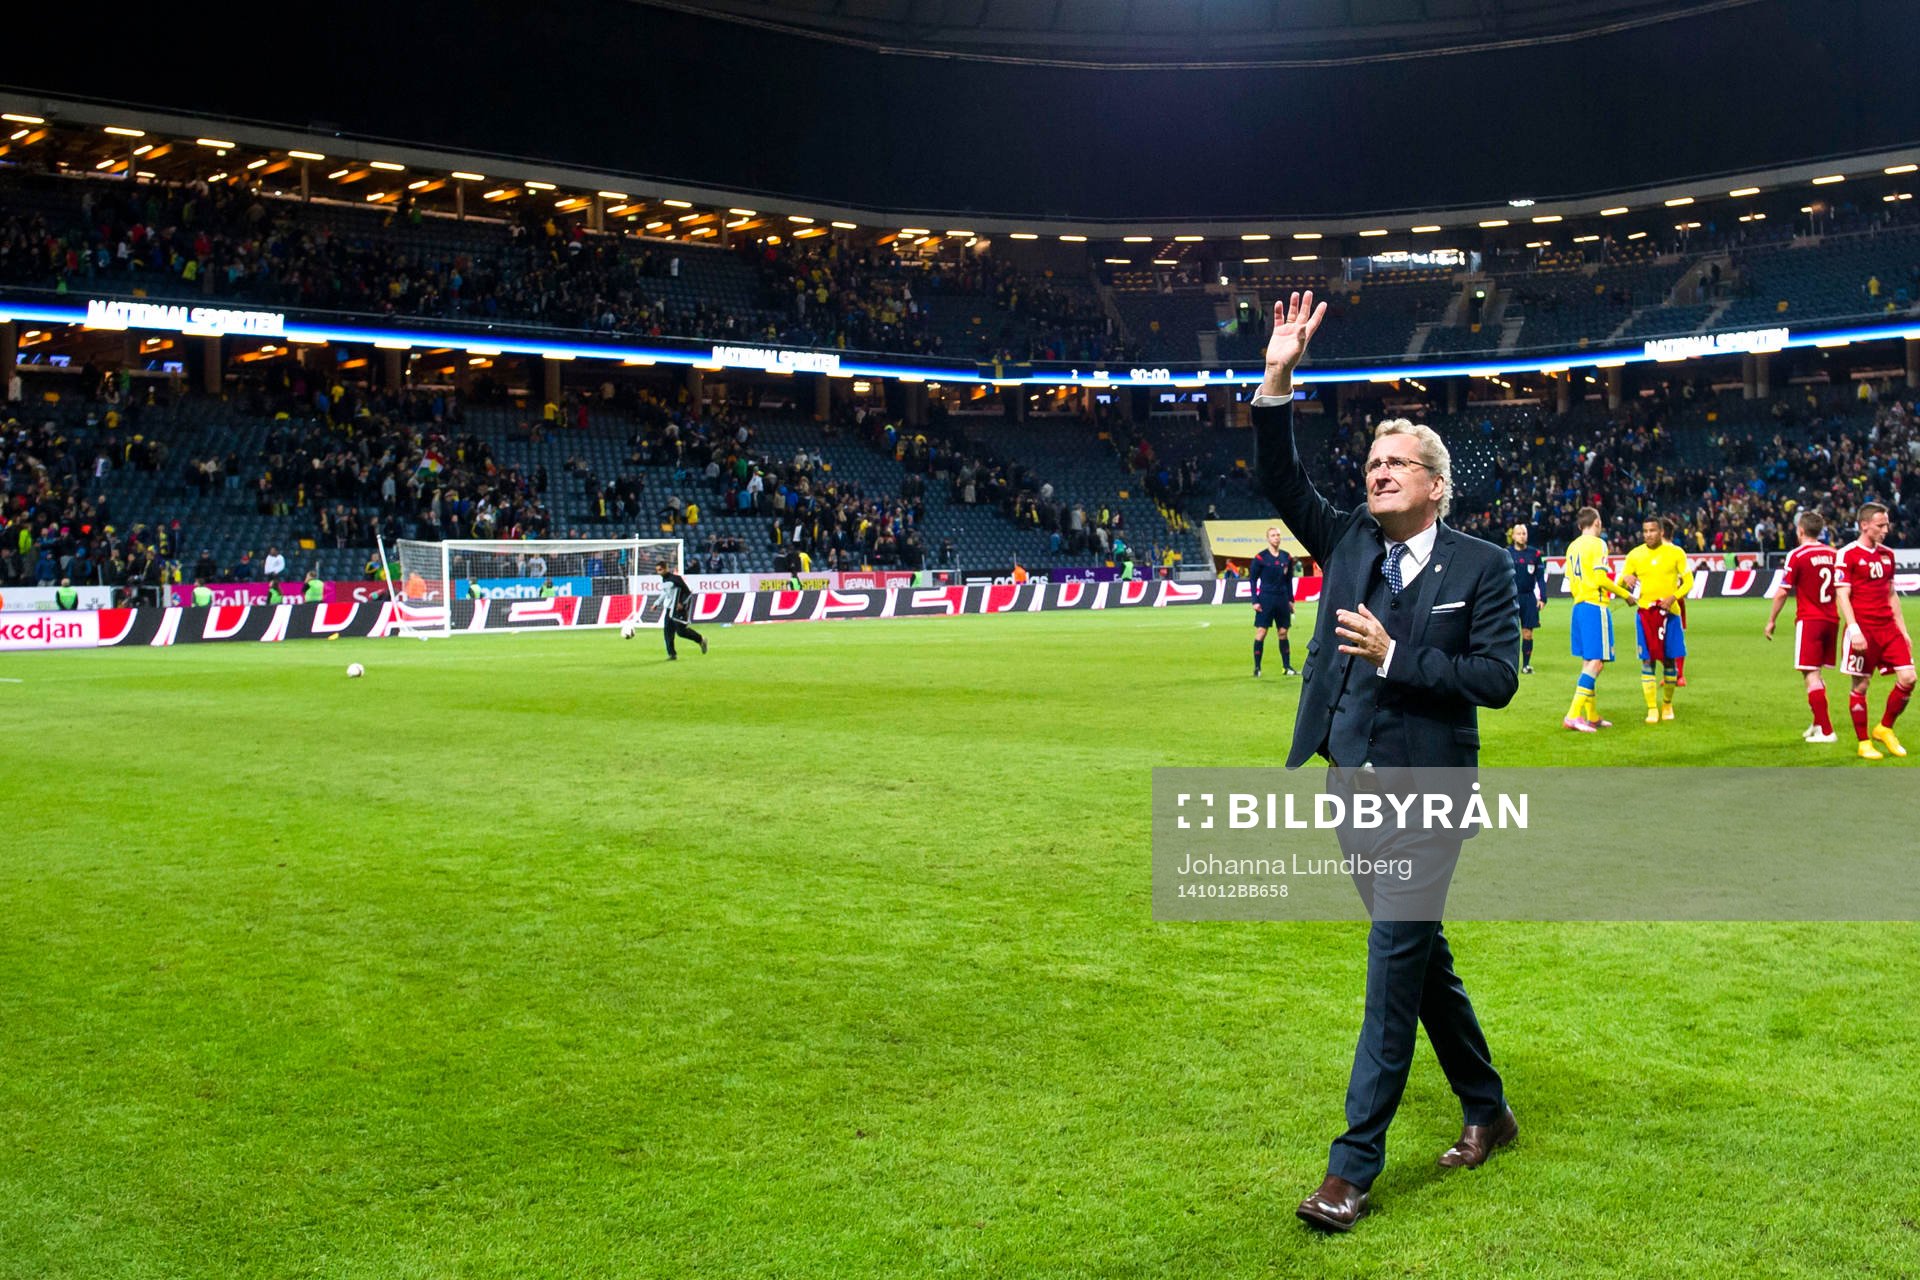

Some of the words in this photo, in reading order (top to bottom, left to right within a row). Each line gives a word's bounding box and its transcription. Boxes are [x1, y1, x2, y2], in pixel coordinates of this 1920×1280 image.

[1868, 561, 1884, 579] 20
[699, 580, 740, 591] RICOH
[1819, 567, 1832, 604] 2
[1848, 654, 1865, 672] 20
